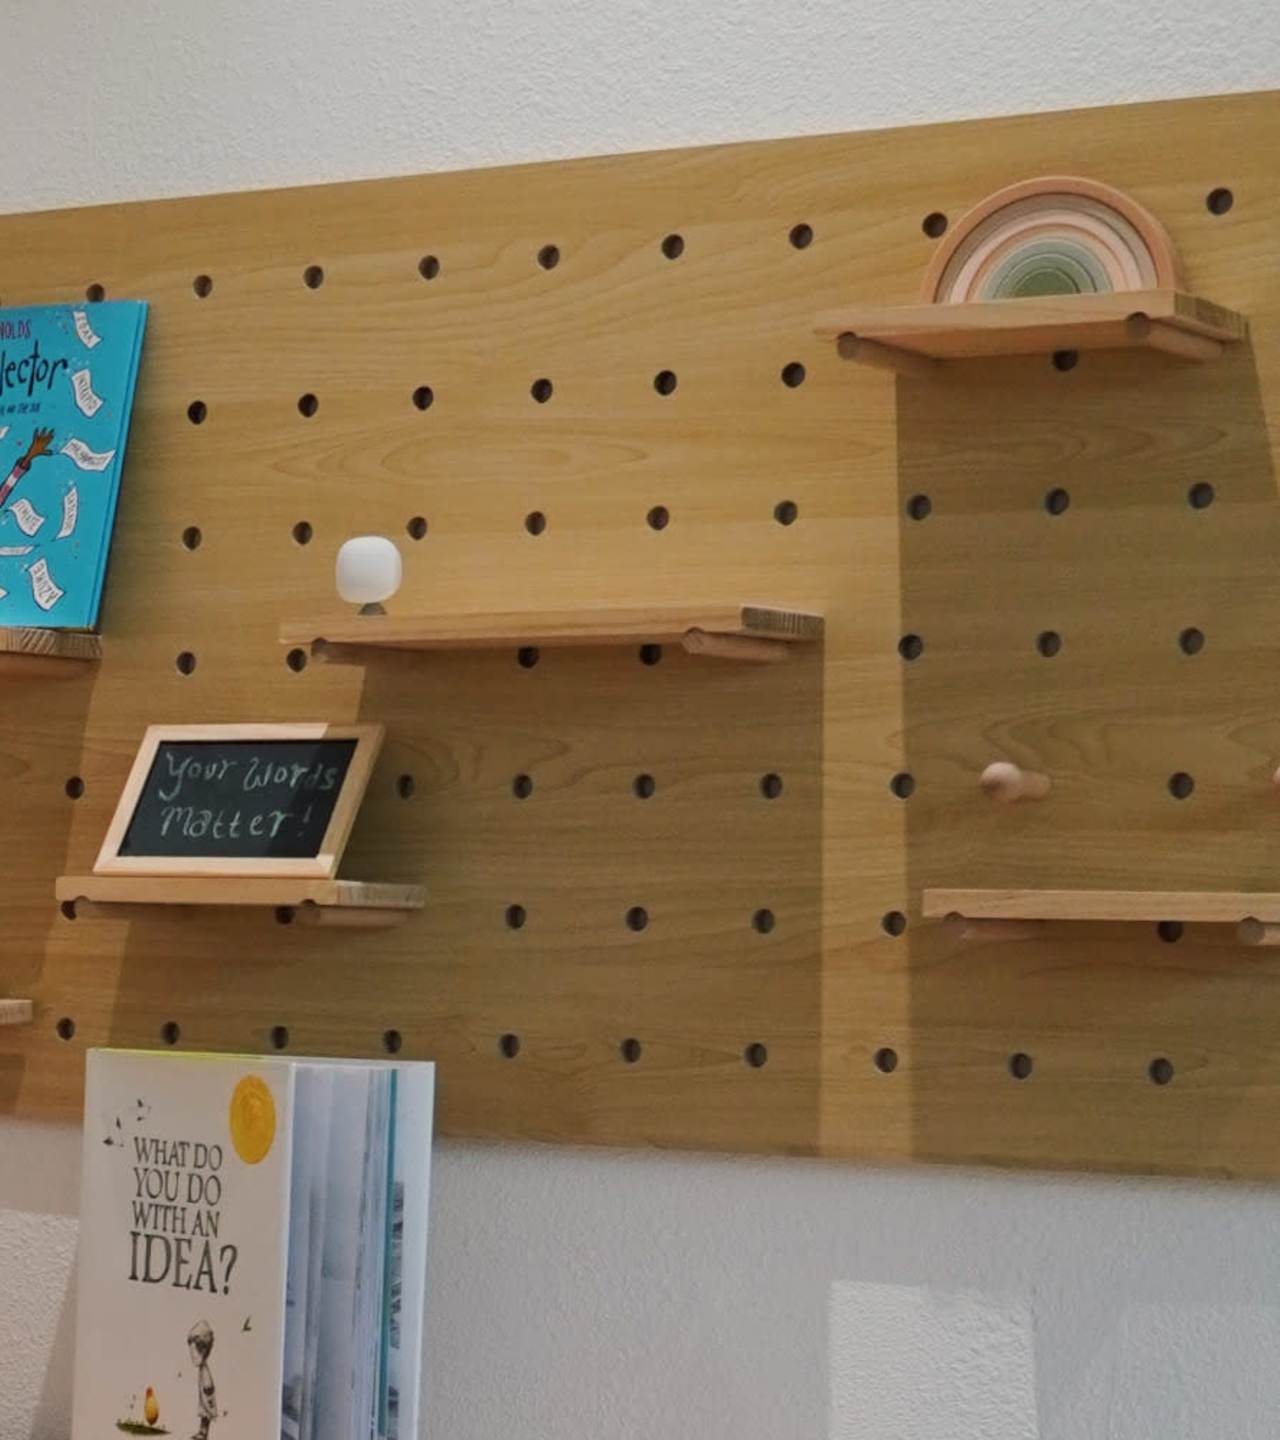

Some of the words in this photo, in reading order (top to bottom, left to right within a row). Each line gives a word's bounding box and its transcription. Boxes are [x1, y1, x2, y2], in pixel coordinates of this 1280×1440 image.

[159, 751, 237, 802] Your
[133, 1136, 191, 1168] WHAT
[193, 1143, 223, 1171] DO
[133, 1166, 181, 1202] YOU
[187, 1172, 222, 1206] DO
[132, 1200, 187, 1234] WITH
[191, 1209, 221, 1238] AN
[128, 1231, 238, 1296] IDEA?
